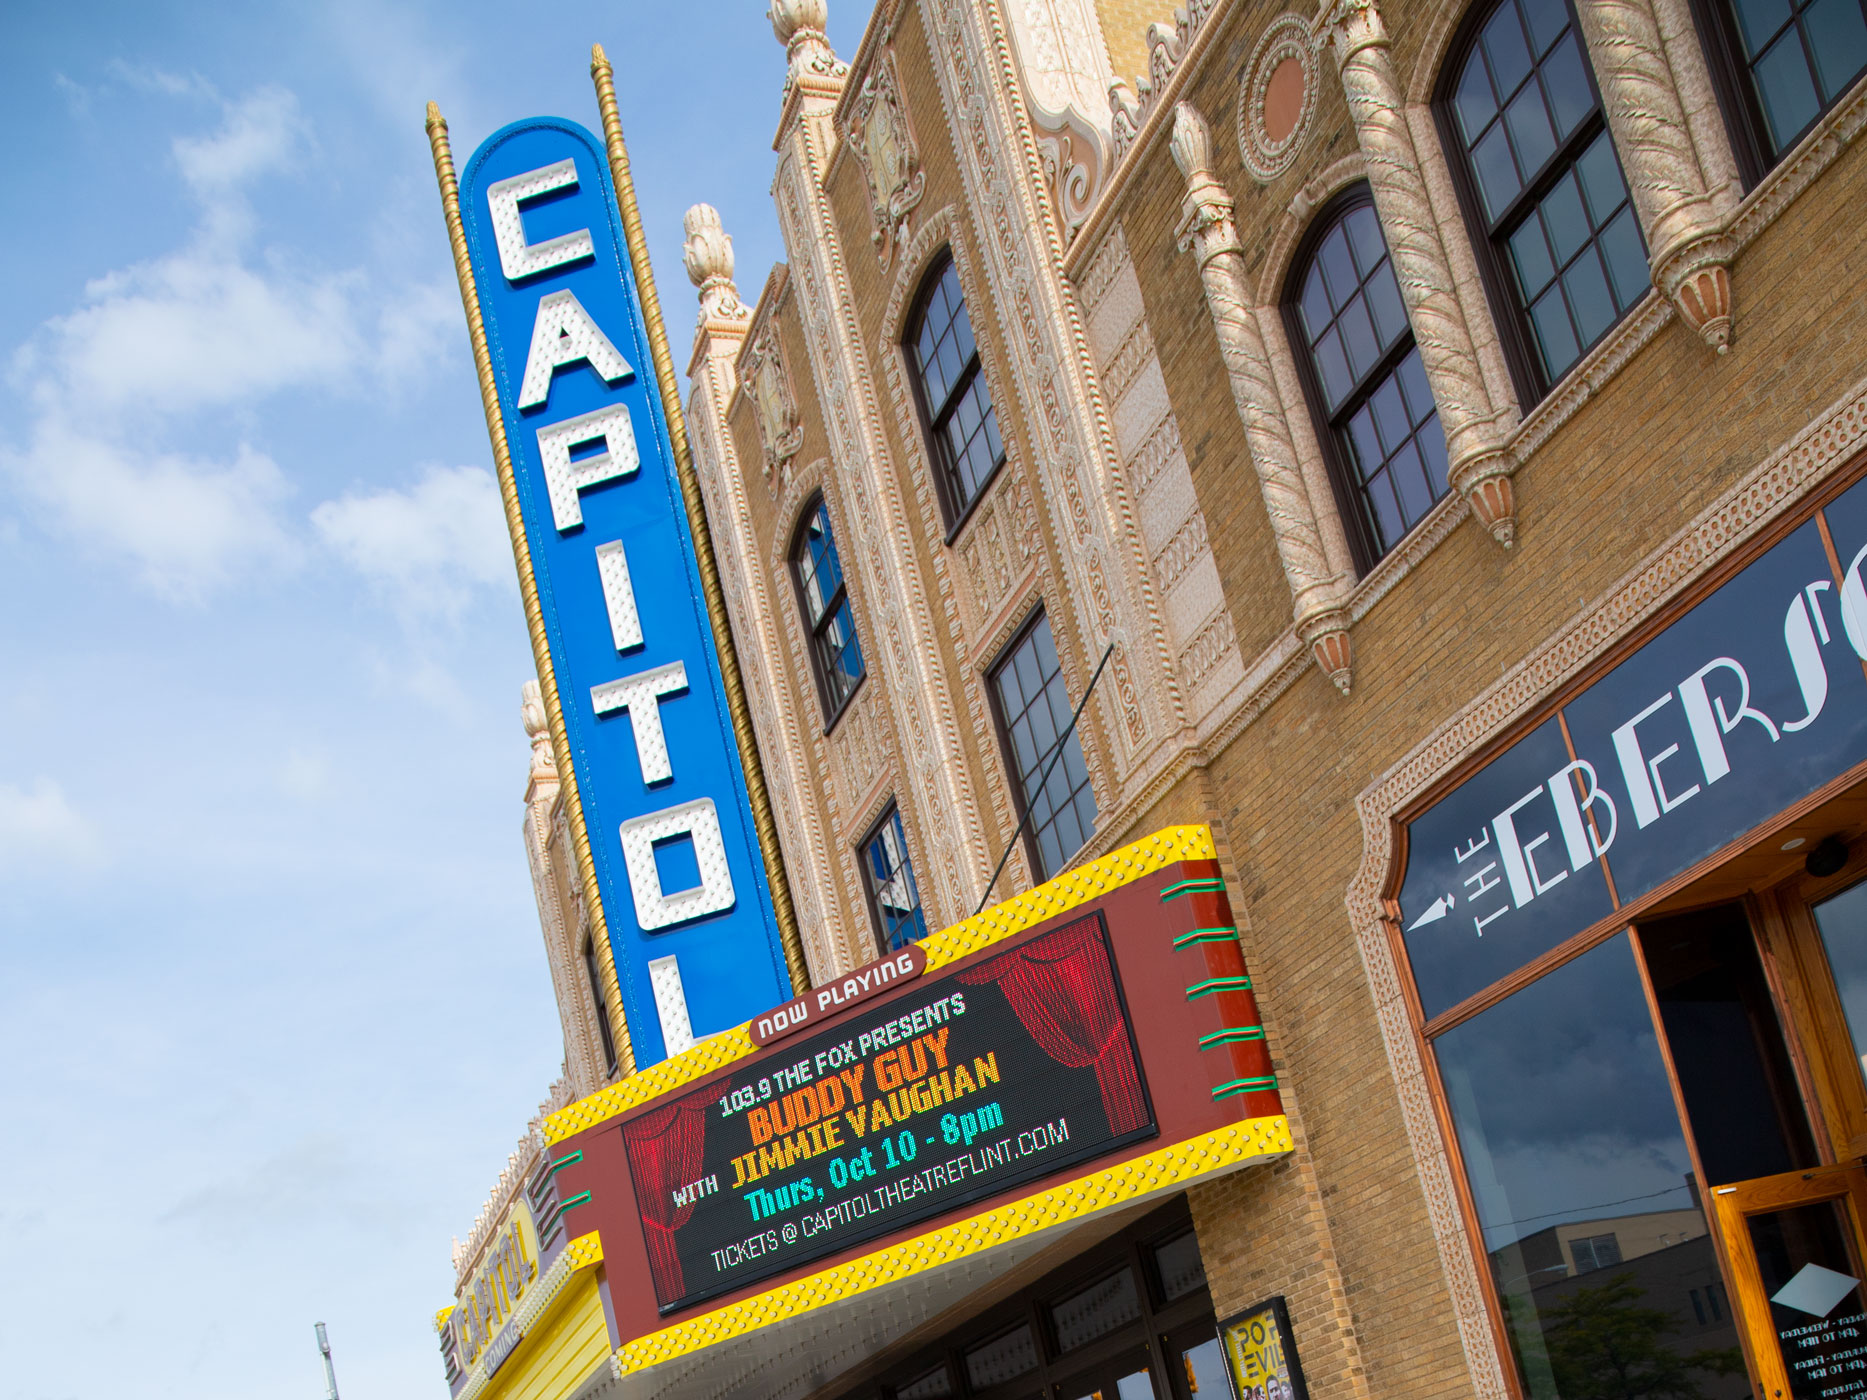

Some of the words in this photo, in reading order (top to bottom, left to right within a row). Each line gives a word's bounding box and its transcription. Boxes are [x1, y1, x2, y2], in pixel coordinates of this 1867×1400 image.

[486, 157, 736, 1060] CAPITOL
[1453, 826, 1510, 938] THE
[720, 1074, 773, 1119] 103.9
[774, 1058, 813, 1093] THE
[814, 1041, 857, 1080] FOX
[857, 992, 967, 1062] PRESENTS
[757, 998, 810, 1039] NOW
[816, 952, 915, 1013] PLAYING
[672, 1174, 720, 1209] WITH
[730, 1126, 845, 1190] JIMMIE
[845, 1051, 1002, 1146] VAUGHAN
[746, 1067, 867, 1148] BUDDY
[874, 1026, 950, 1096] GUY
[711, 1227, 780, 1273] TICKETS
[781, 1222, 798, 1246] @
[800, 1118, 1070, 1240] CAPITOLTHEATREFLINT.COM
[743, 1173, 825, 1223] Thurs,
[828, 1154, 877, 1192] Oct
[882, 1134, 918, 1172] 10
[941, 1100, 1005, 1150] 8pm
[456, 1220, 538, 1366] CAPITOL
[1244, 1343, 1286, 1379] EVIL
